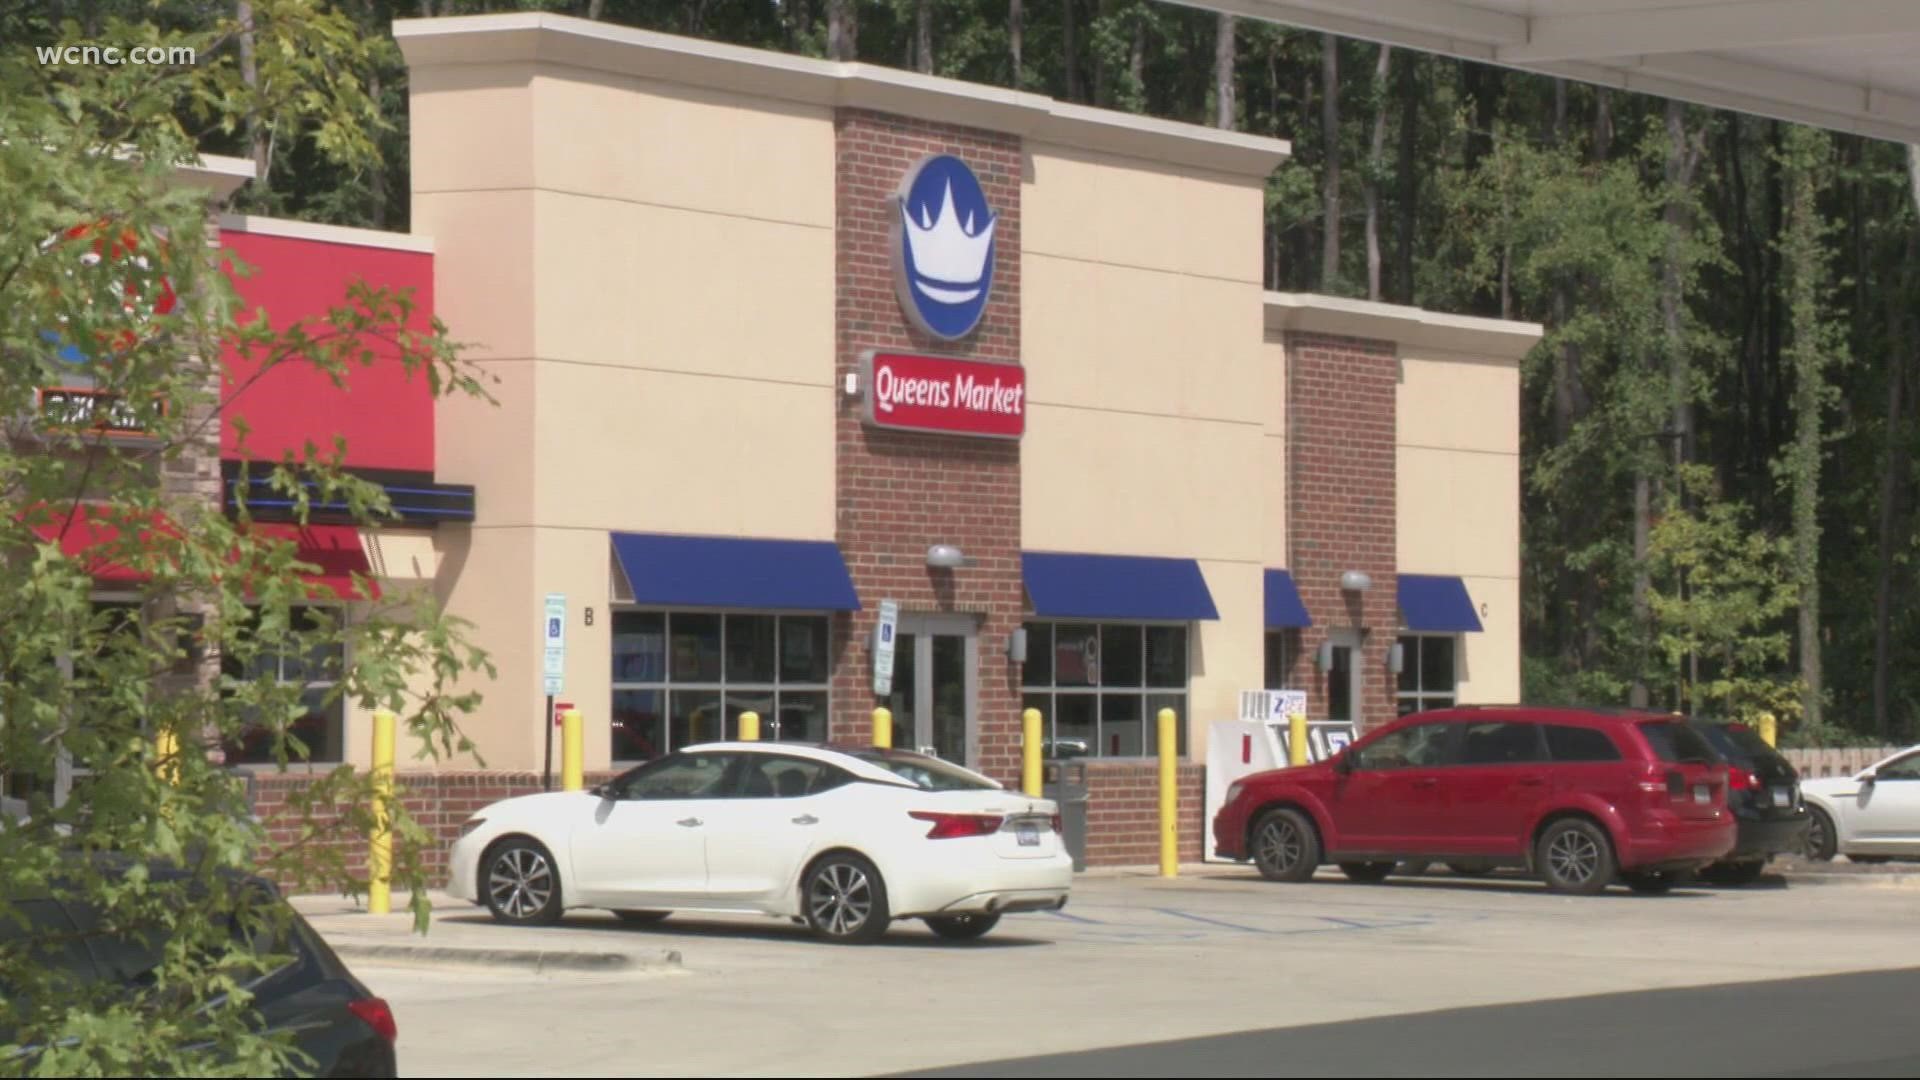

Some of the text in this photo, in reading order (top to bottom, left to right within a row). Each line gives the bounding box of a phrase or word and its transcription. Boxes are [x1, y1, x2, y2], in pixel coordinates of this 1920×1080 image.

[877, 365, 1023, 415] Queens Market
[584, 607, 593, 626] B
[1480, 602, 1487, 618] C
